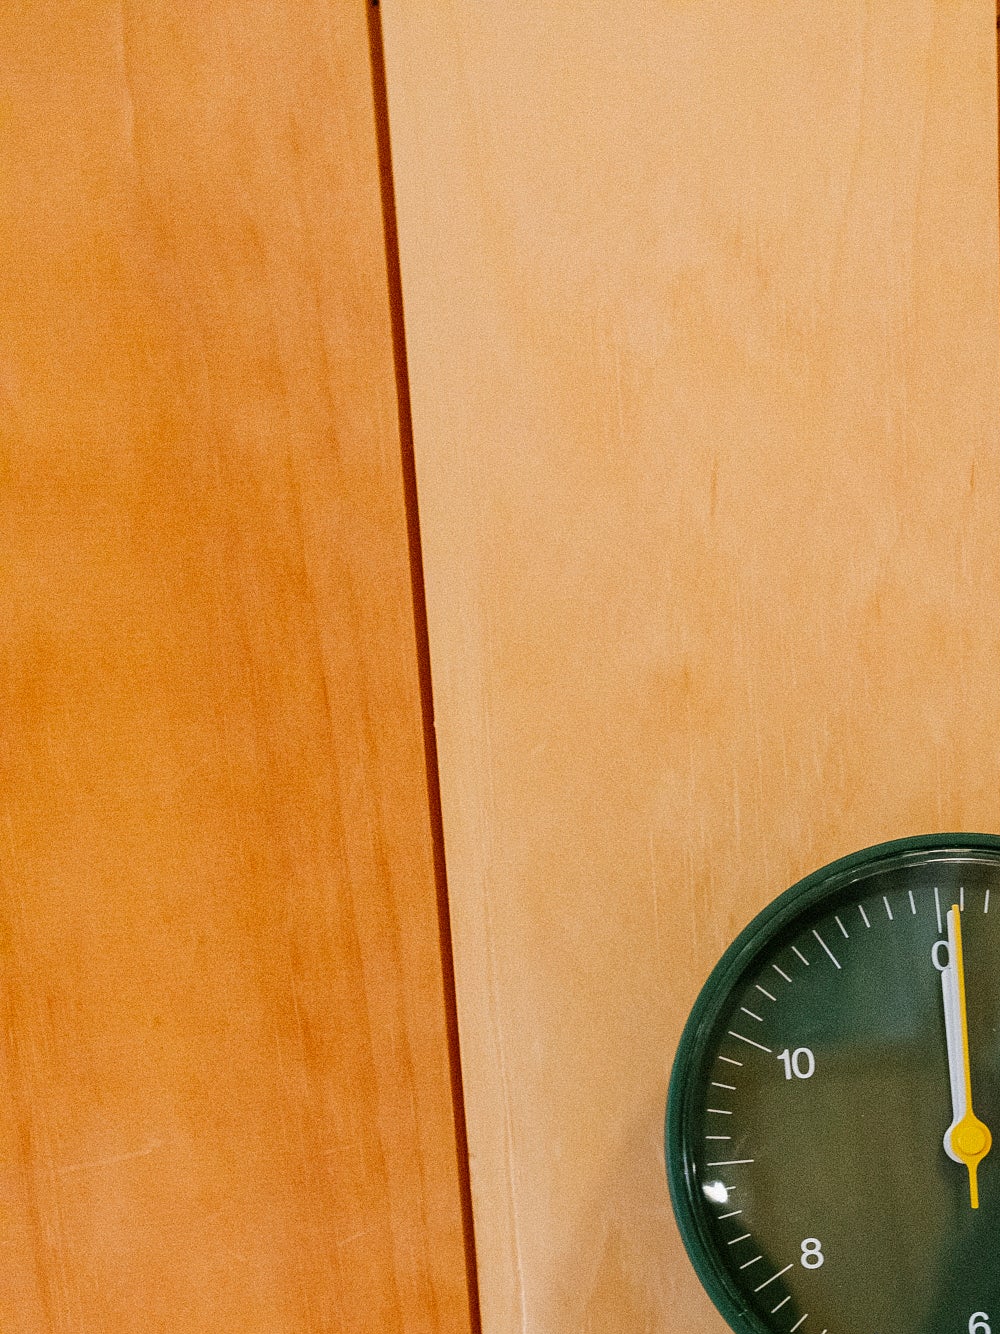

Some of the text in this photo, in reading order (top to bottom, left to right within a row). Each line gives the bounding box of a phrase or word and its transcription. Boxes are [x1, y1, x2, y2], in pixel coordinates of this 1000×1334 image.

[931, 940, 952, 971] 0
[778, 1048, 814, 1079] 10
[801, 1238, 824, 1269] 8
